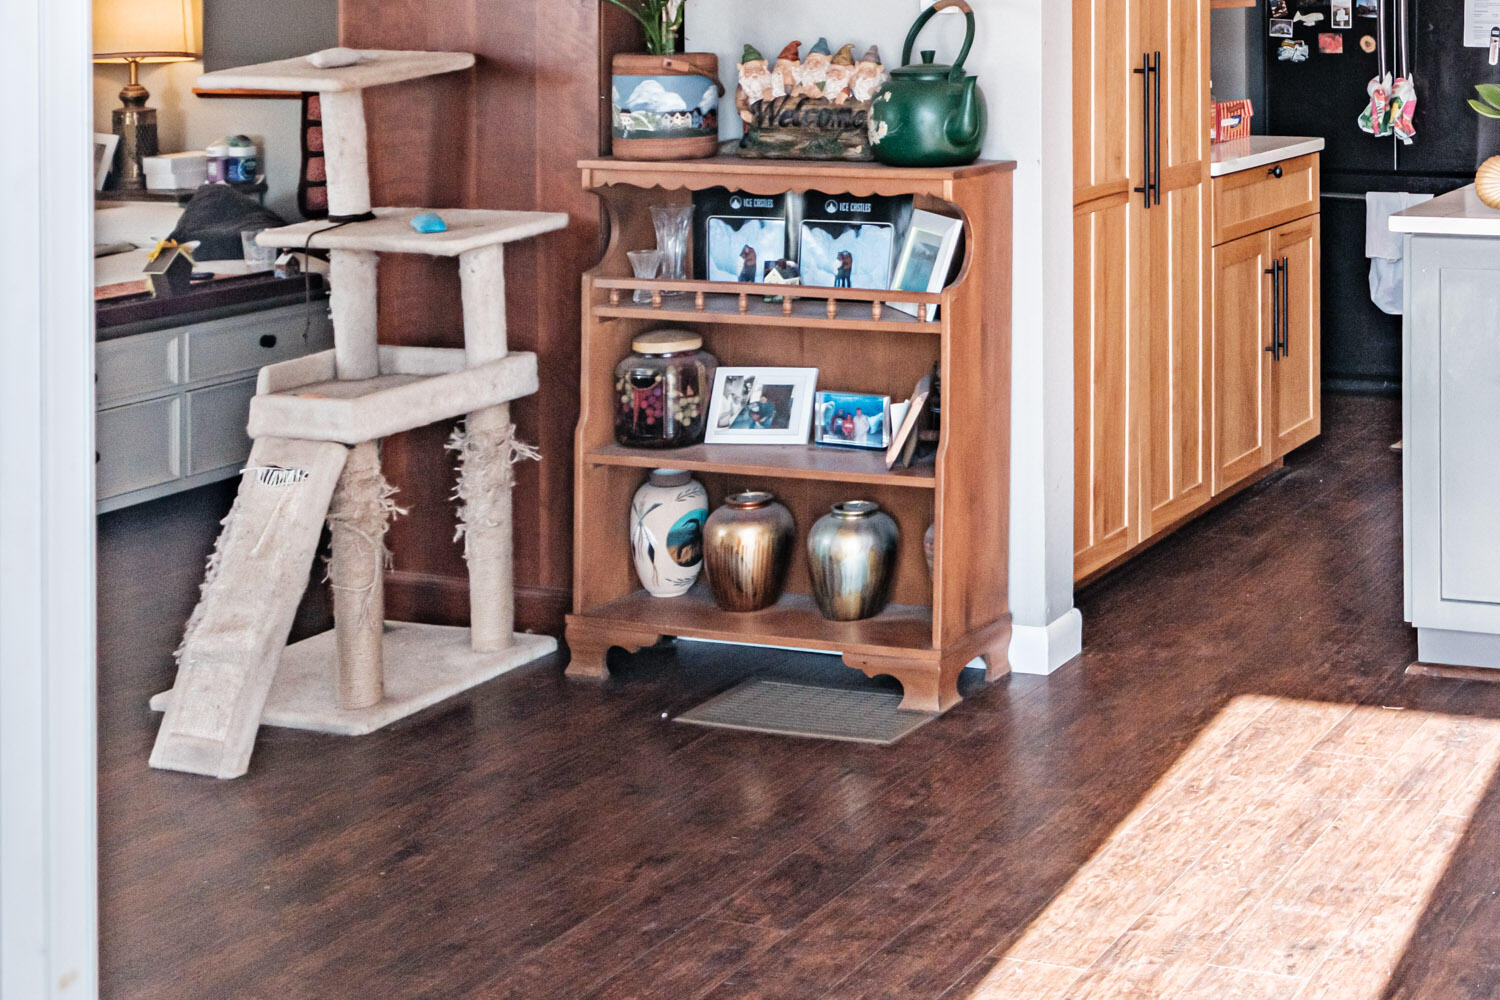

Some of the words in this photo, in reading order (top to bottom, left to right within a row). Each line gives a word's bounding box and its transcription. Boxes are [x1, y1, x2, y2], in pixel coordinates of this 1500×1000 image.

[750, 94, 867, 129] Welcome
[743, 198, 753, 207] ICE
[753, 199, 774, 208] CASTLES
[839, 202, 849, 212] ICE
[850, 202, 872, 213] CASTLES
